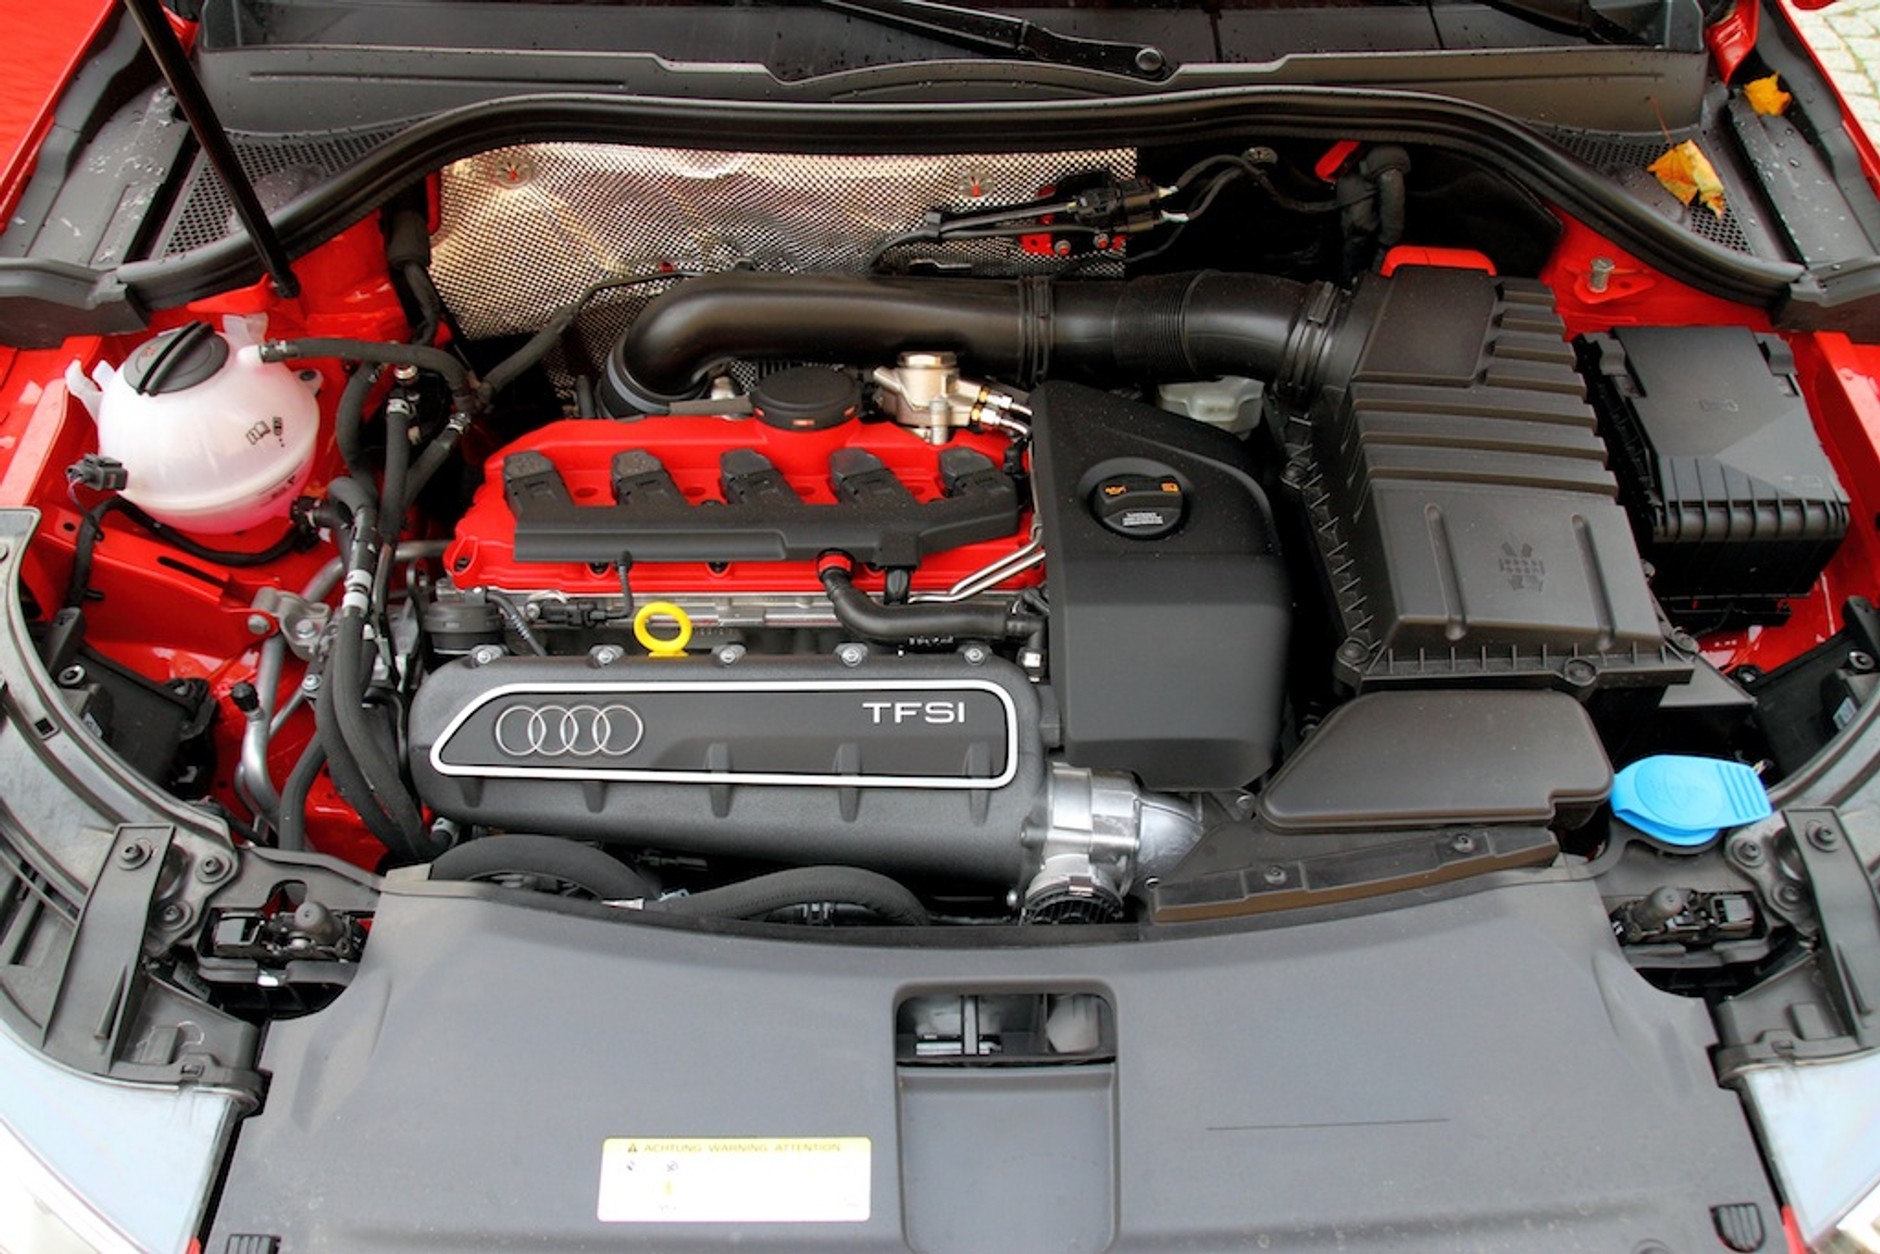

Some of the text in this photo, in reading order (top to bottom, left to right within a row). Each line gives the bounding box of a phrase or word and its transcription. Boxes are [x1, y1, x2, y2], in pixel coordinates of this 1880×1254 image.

[862, 702, 965, 723] TFSI
[644, 1143, 841, 1153] ACHTUNG WARNING ATTENTION
